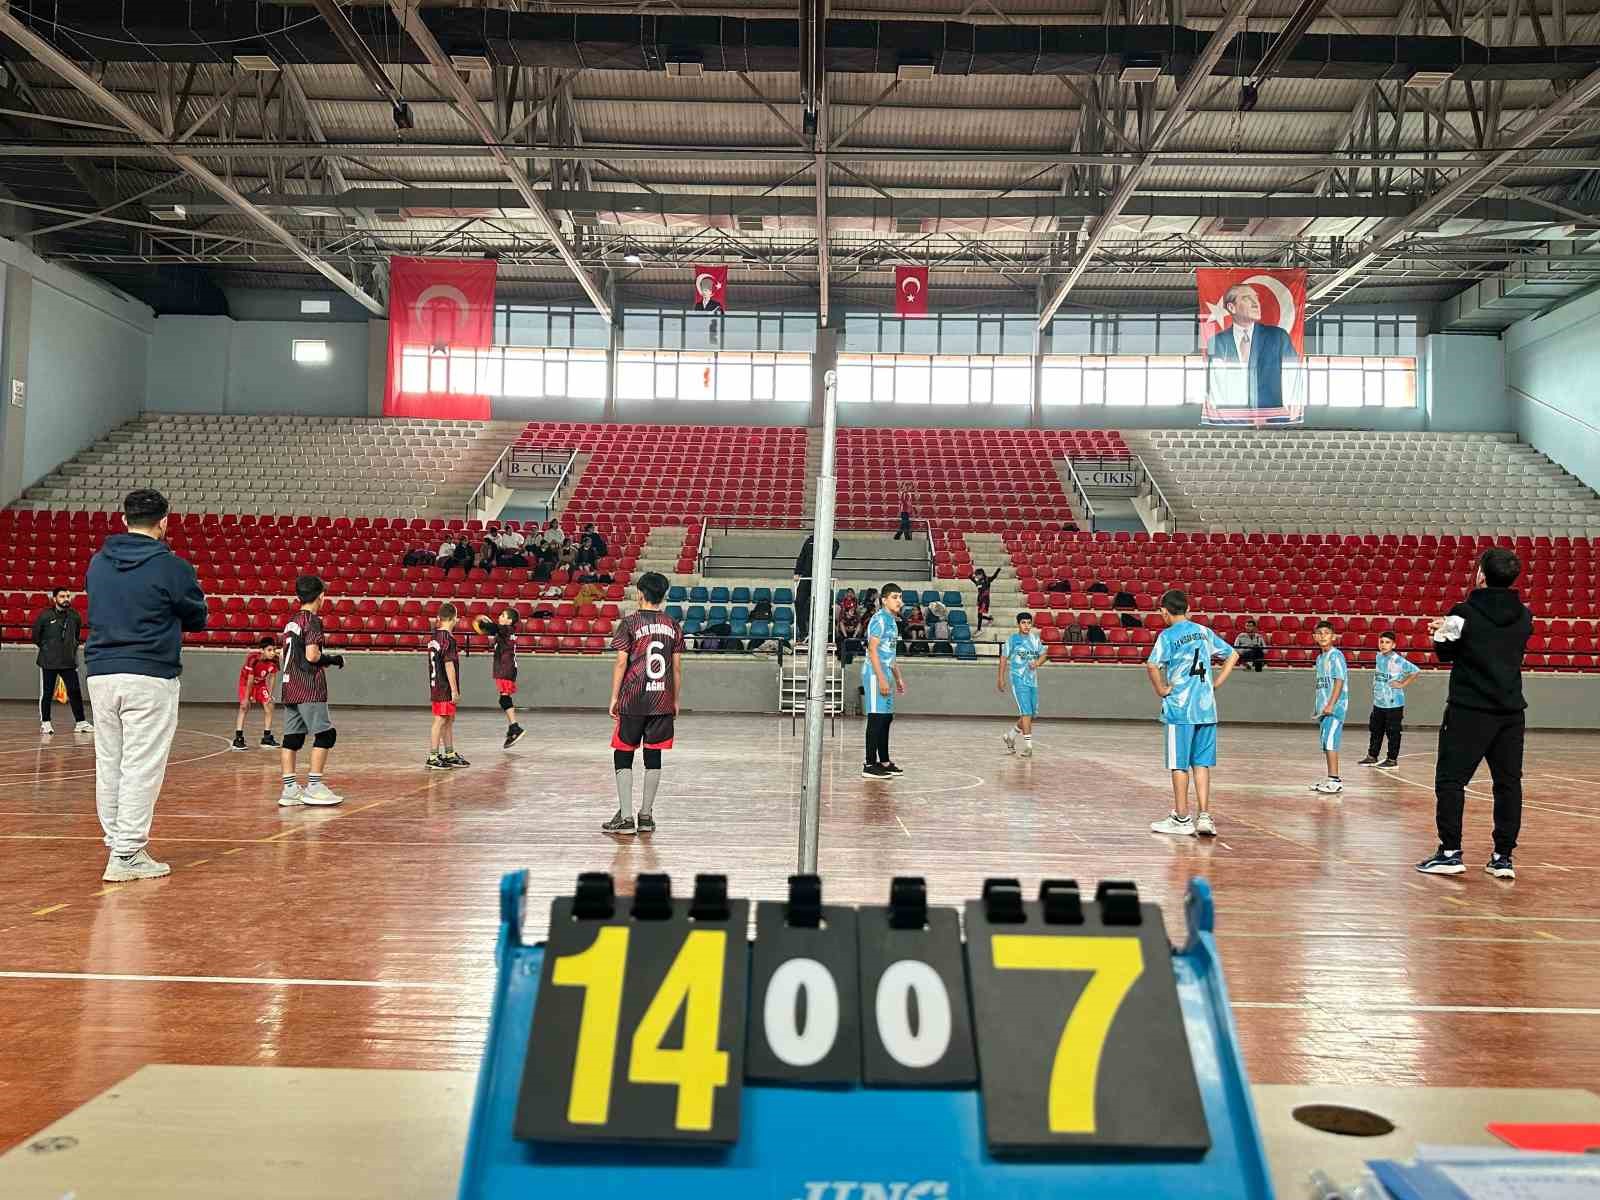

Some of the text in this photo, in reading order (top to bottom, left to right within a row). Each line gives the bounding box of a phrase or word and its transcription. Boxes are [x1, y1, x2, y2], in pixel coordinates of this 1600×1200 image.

[511, 462, 520, 474] B
[645, 640, 666, 680] 6
[1189, 647, 1207, 683] 4
[552, 926, 1144, 1133] 14 0 0 7
